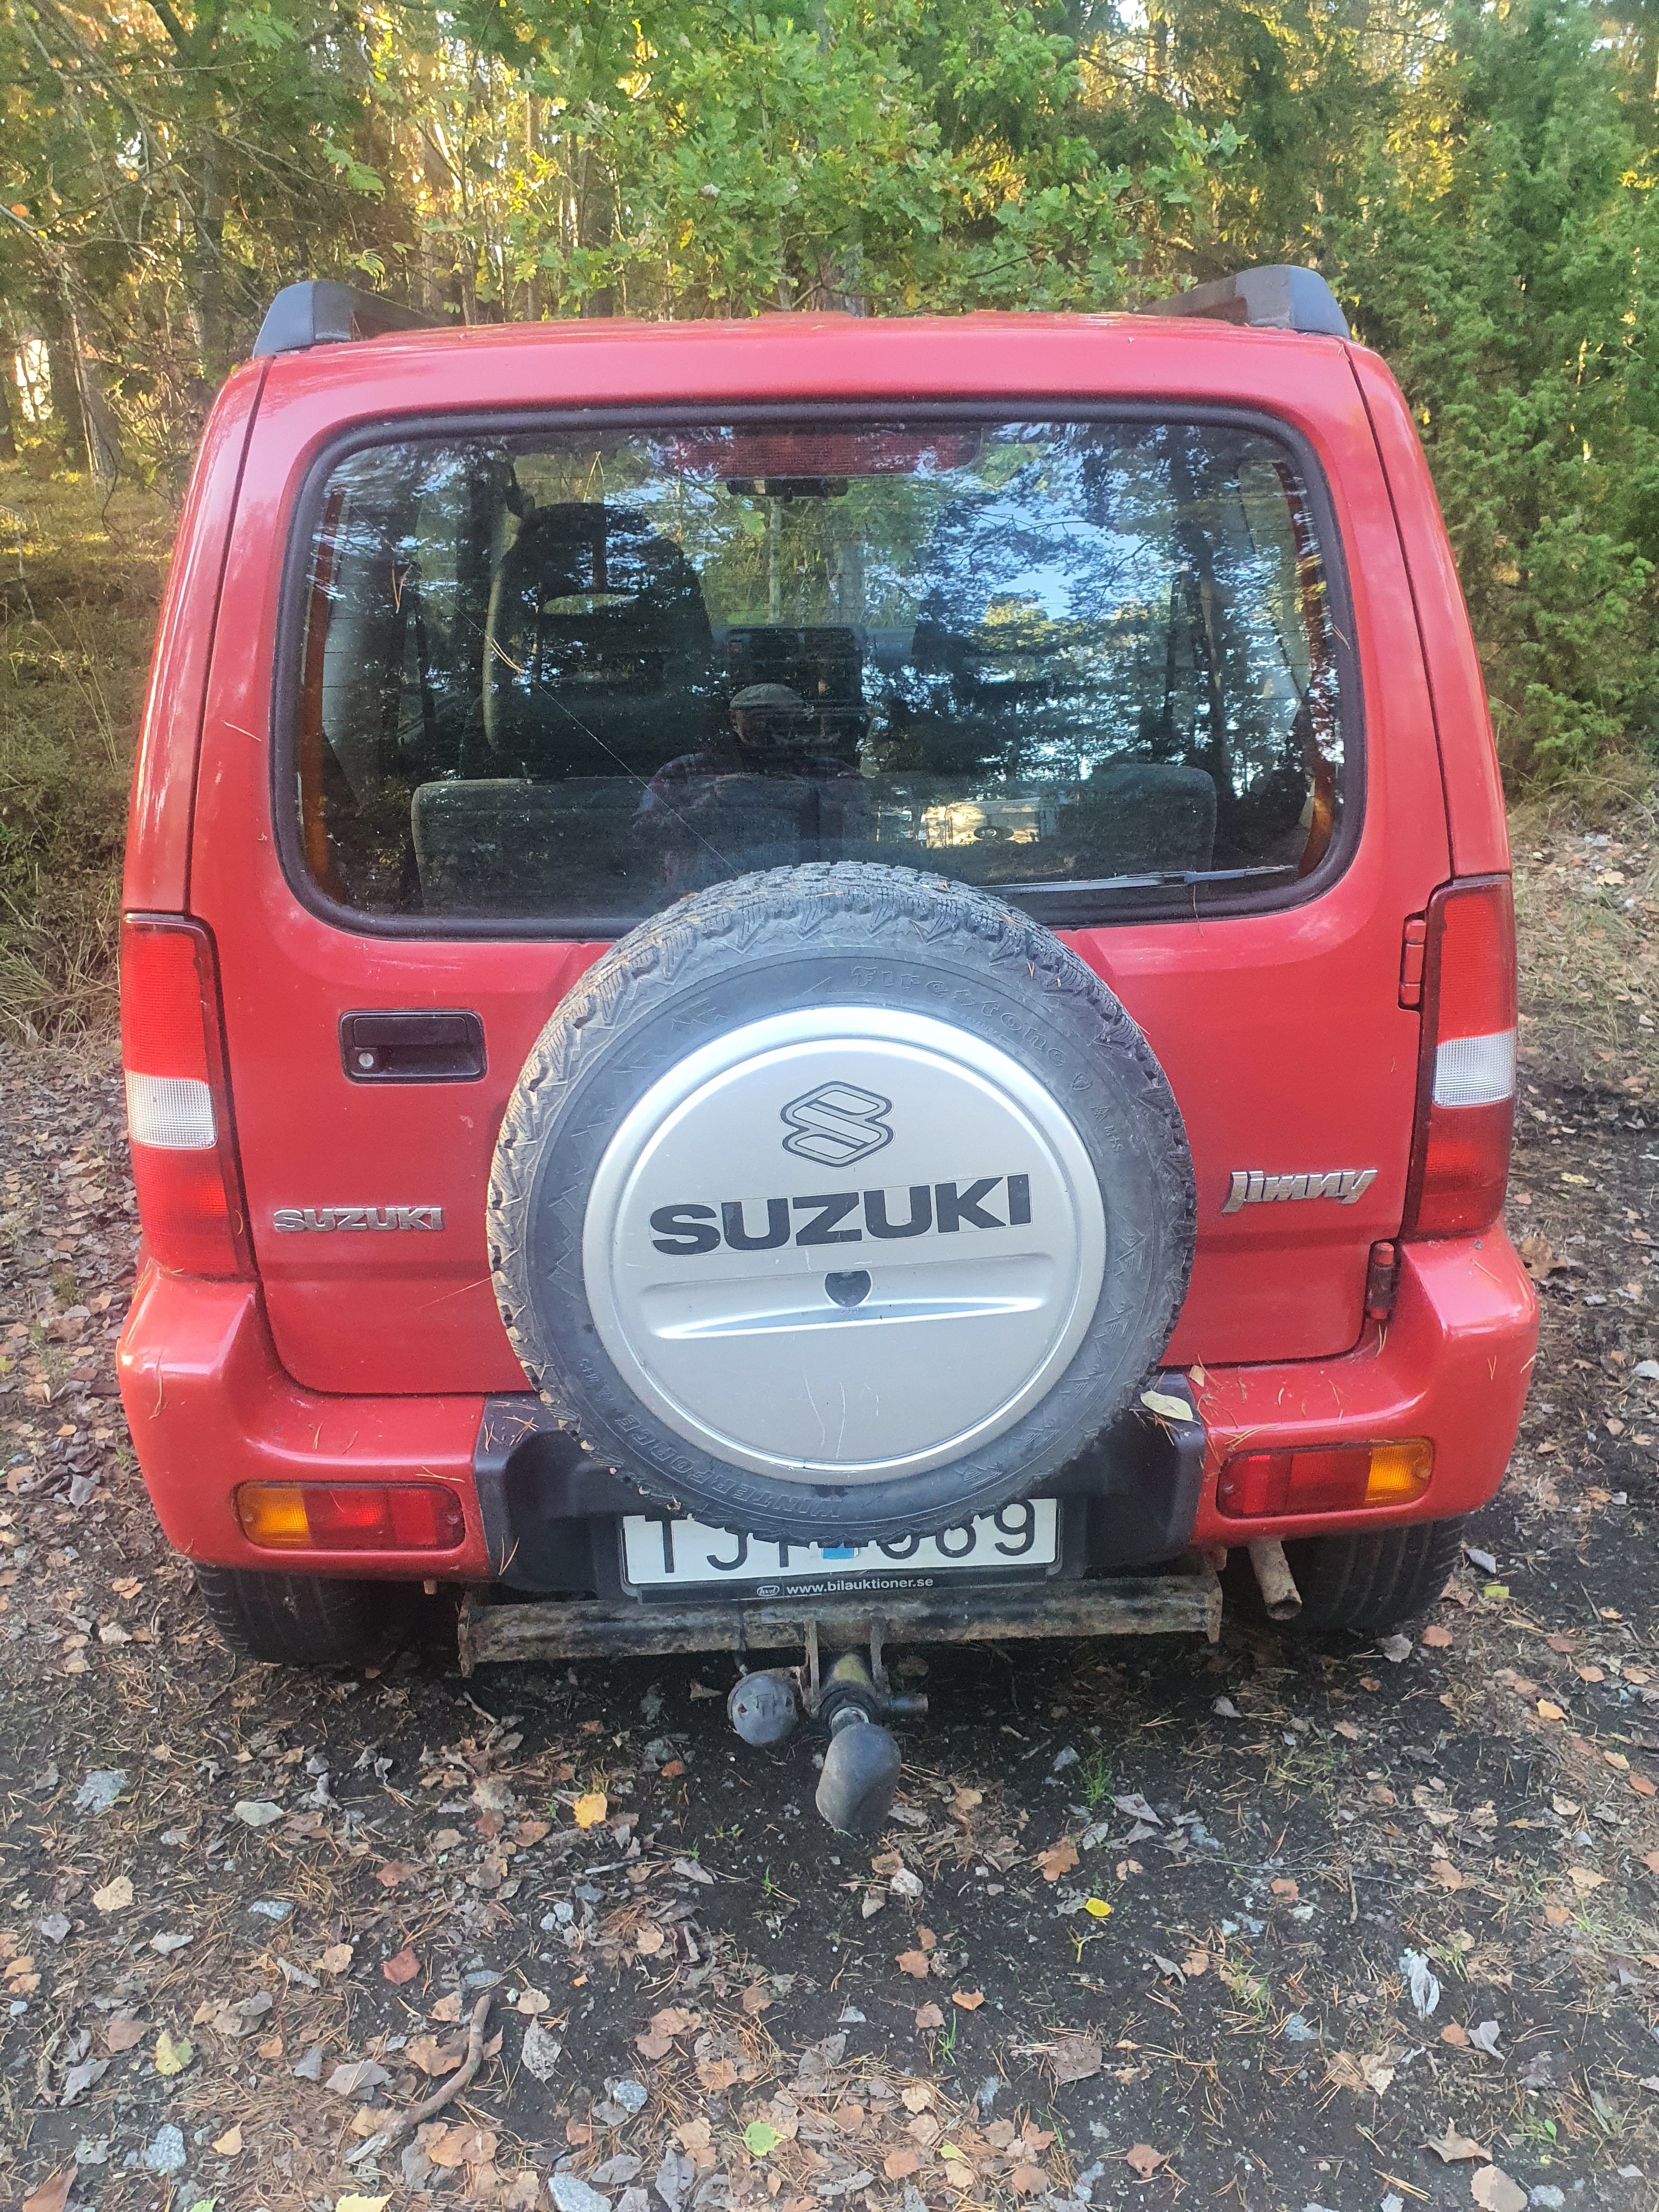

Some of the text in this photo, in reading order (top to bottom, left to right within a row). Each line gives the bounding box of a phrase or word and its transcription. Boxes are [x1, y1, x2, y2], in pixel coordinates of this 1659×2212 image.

[851, 966, 1066, 1067] Firestone
[274, 1207, 443, 1231] SUZUKI
[649, 1173, 1032, 1255] SUZUKI
[1221, 1169, 1378, 1214] Jimny
[614, 1414, 843, 1517] WINTERFORCE
[786, 1578, 933, 1594] www.bilauktioner.se
